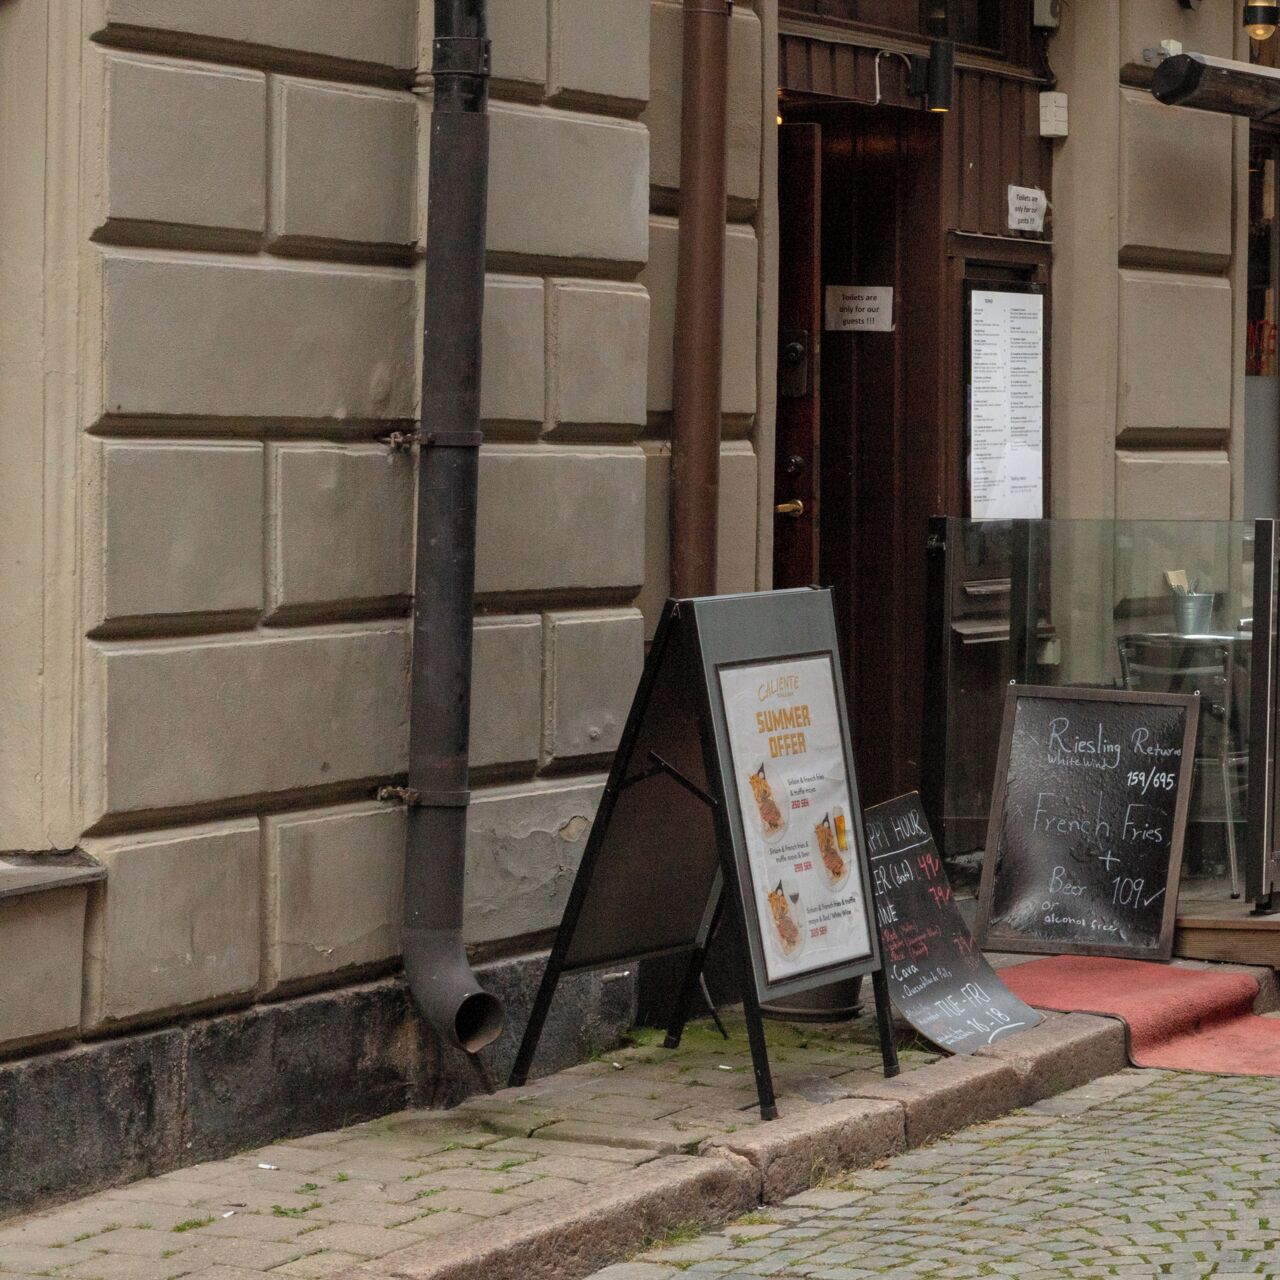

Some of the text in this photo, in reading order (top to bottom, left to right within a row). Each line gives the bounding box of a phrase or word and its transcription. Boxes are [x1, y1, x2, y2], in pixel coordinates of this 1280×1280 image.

[839, 306, 853, 314] only
[842, 318, 864, 326] guests
[757, 674, 799, 702] CALIENTE
[755, 704, 811, 733] SUMMER
[768, 732, 806, 758] OFFER
[1049, 718, 1121, 769] Riesling
[1127, 766, 1175, 795] 159/695
[1033, 793, 1110, 837] French
[1050, 866, 1087, 896] Beer
[1090, 919, 1118, 932] free
[893, 964, 919, 981] Cava
